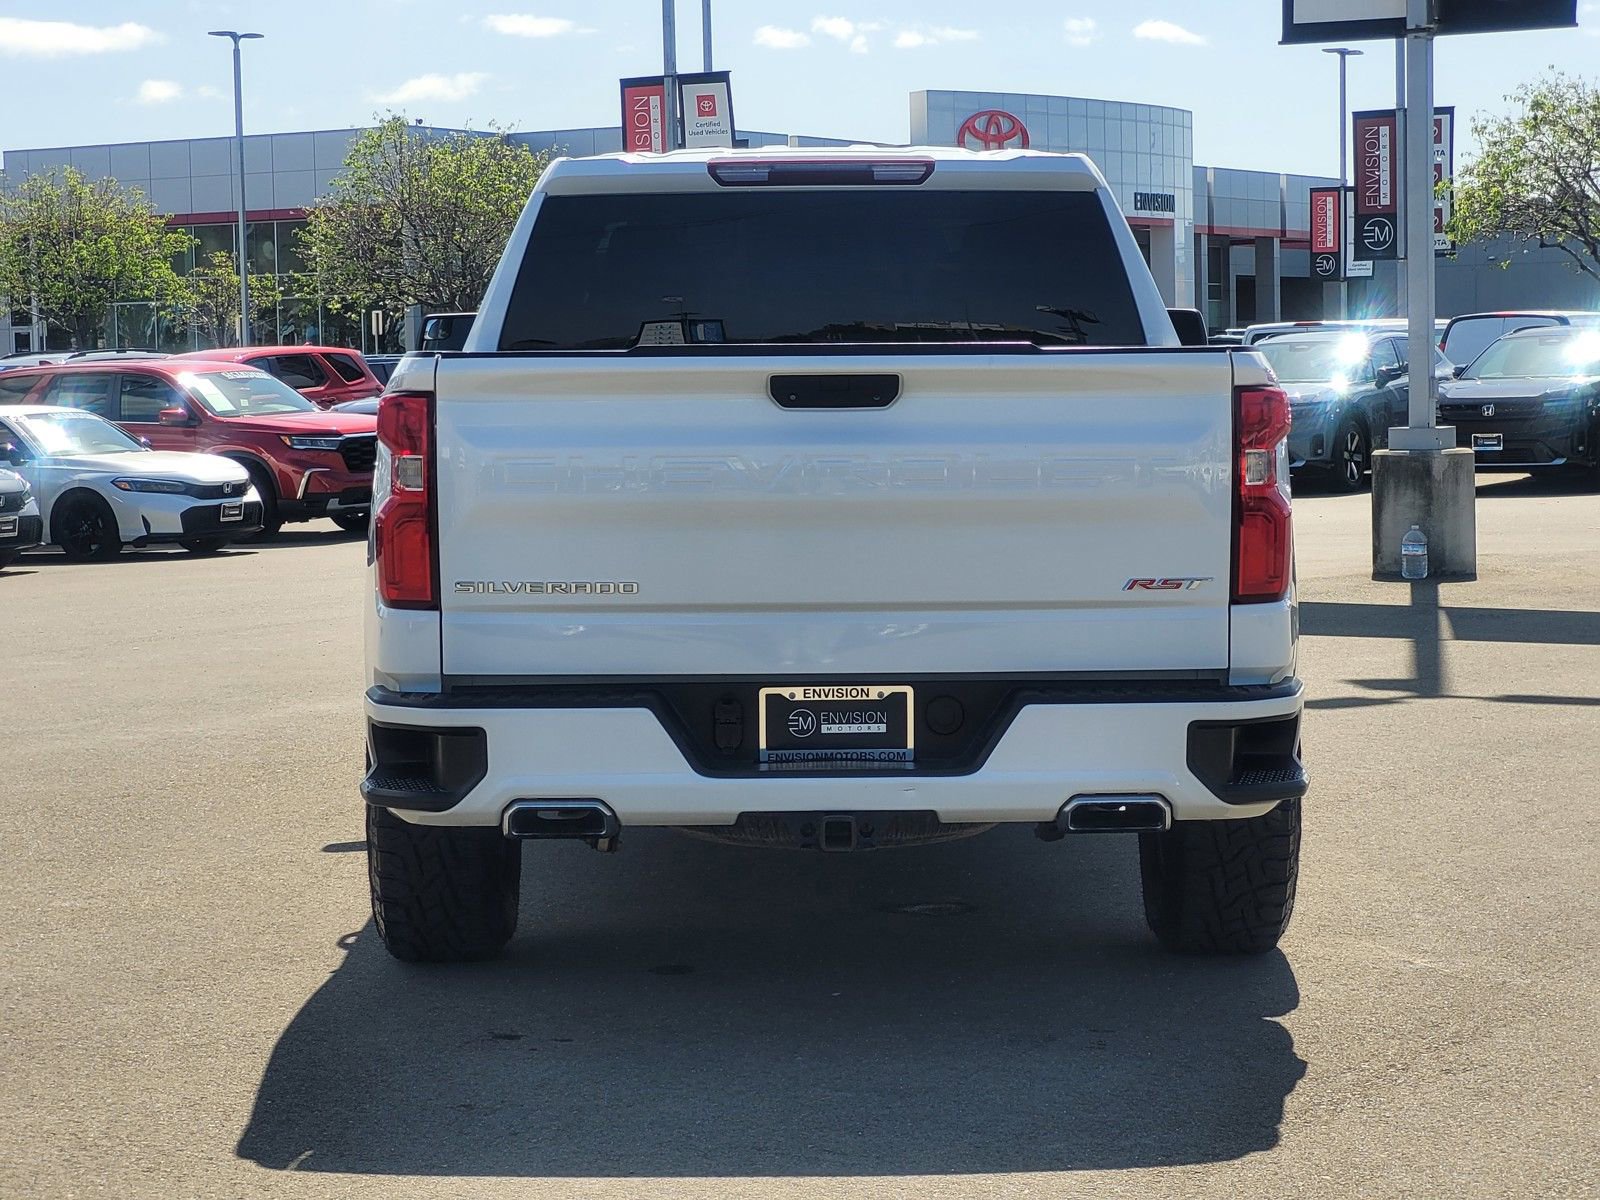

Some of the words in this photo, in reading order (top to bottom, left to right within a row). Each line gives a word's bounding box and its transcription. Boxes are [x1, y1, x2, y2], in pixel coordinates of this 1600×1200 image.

[634, 96, 650, 151] ISION
[705, 128, 728, 136] Vehicles
[1365, 126, 1379, 207] ENVISION
[1134, 192, 1175, 212] ENVISION
[1317, 196, 1327, 248] ENVISION
[454, 581, 640, 595] SILVERADO
[1122, 577, 1214, 591] RST
[803, 687, 870, 699] ENVISION
[820, 711, 887, 724] ENVISION
[767, 752, 906, 763] ENVISIONMOTORS.COM
